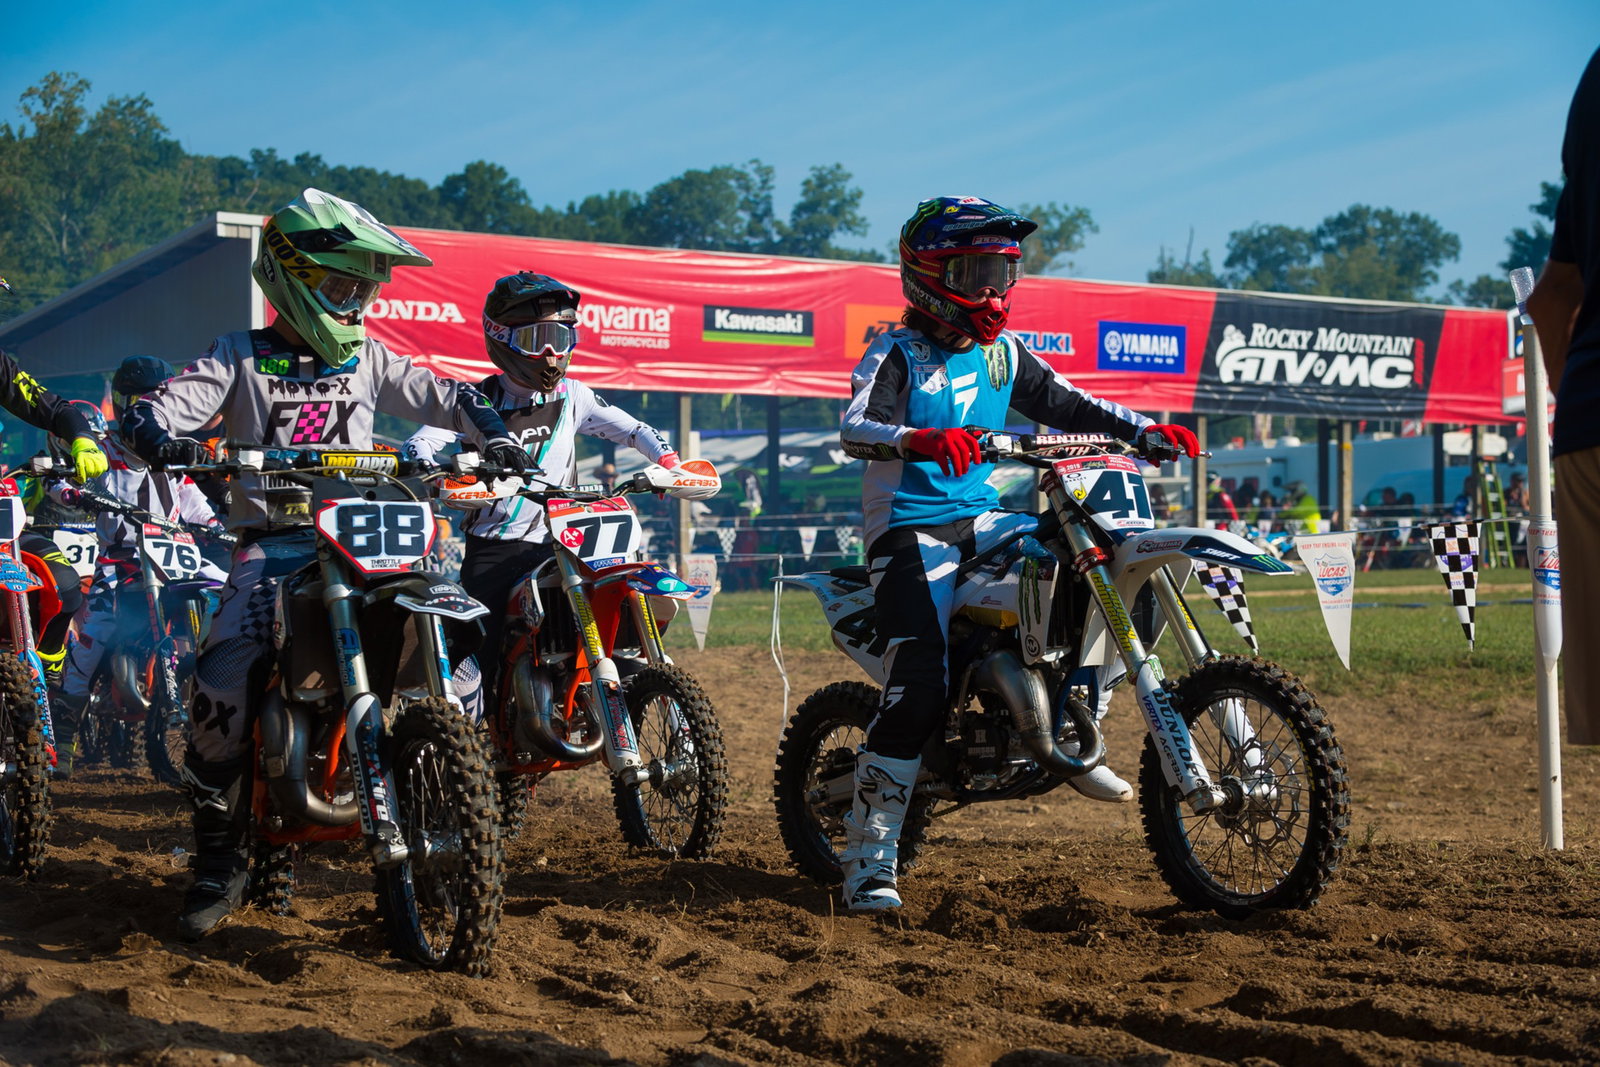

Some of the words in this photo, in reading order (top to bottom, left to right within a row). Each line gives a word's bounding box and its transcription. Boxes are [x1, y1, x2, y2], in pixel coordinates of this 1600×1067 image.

[263, 224, 316, 279] 100%
[359, 300, 465, 323] ONDA
[575, 304, 670, 333] sqvarna
[714, 309, 804, 333] Kawasaki
[600, 336, 670, 348] MOTORCYCLES
[862, 320, 903, 344] KT
[1018, 333, 1073, 354] ZUKI
[1248, 323, 1312, 350] ROCKY
[1313, 327, 1415, 357] MOUNTAIN
[1122, 333, 1178, 357] YAMAHA
[258, 357, 290, 375] 180
[267, 377, 352, 399] MOTO-X
[1036, 434, 1109, 444] RENTHAL
[672, 478, 718, 487] ACERBIS
[448, 491, 496, 500] ACERBIS
[1081, 470, 1152, 520] 41
[337, 504, 425, 557] 88
[566, 514, 632, 559] 77
[66, 545, 95, 565] 31
[153, 542, 198, 571] 76
[1201, 548, 1242, 560] SHIFT
[1319, 566, 1347, 578] LUCAS
[192, 691, 237, 737] OX
[1142, 695, 1165, 732] VERTEX
[1152, 689, 1199, 776] DUNLOP
[1159, 737, 1183, 783] ACERBIS
[352, 753, 373, 830] DUNLOP
